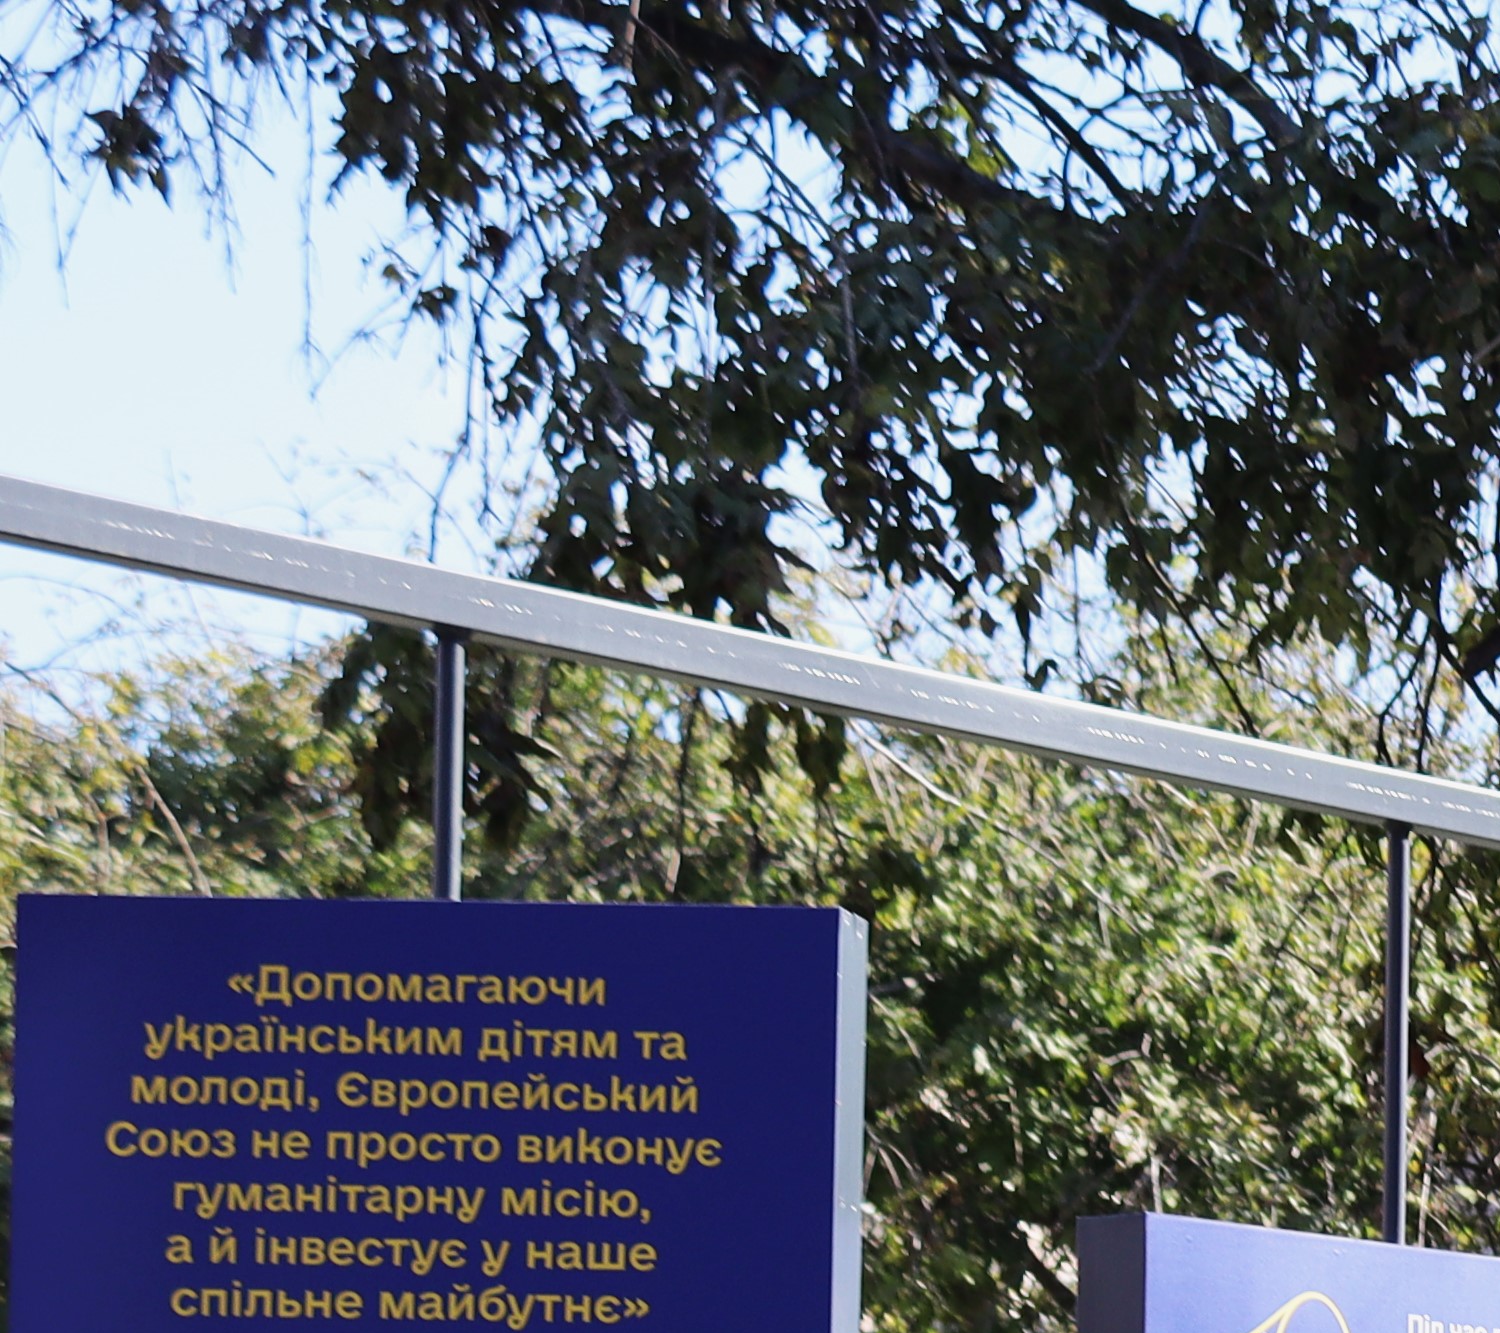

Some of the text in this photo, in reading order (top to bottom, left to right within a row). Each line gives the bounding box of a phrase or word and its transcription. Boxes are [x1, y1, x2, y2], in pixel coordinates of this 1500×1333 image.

[131, 1068, 698, 1117] молоді, Європейський
[170, 1280, 364, 1320] спільне
